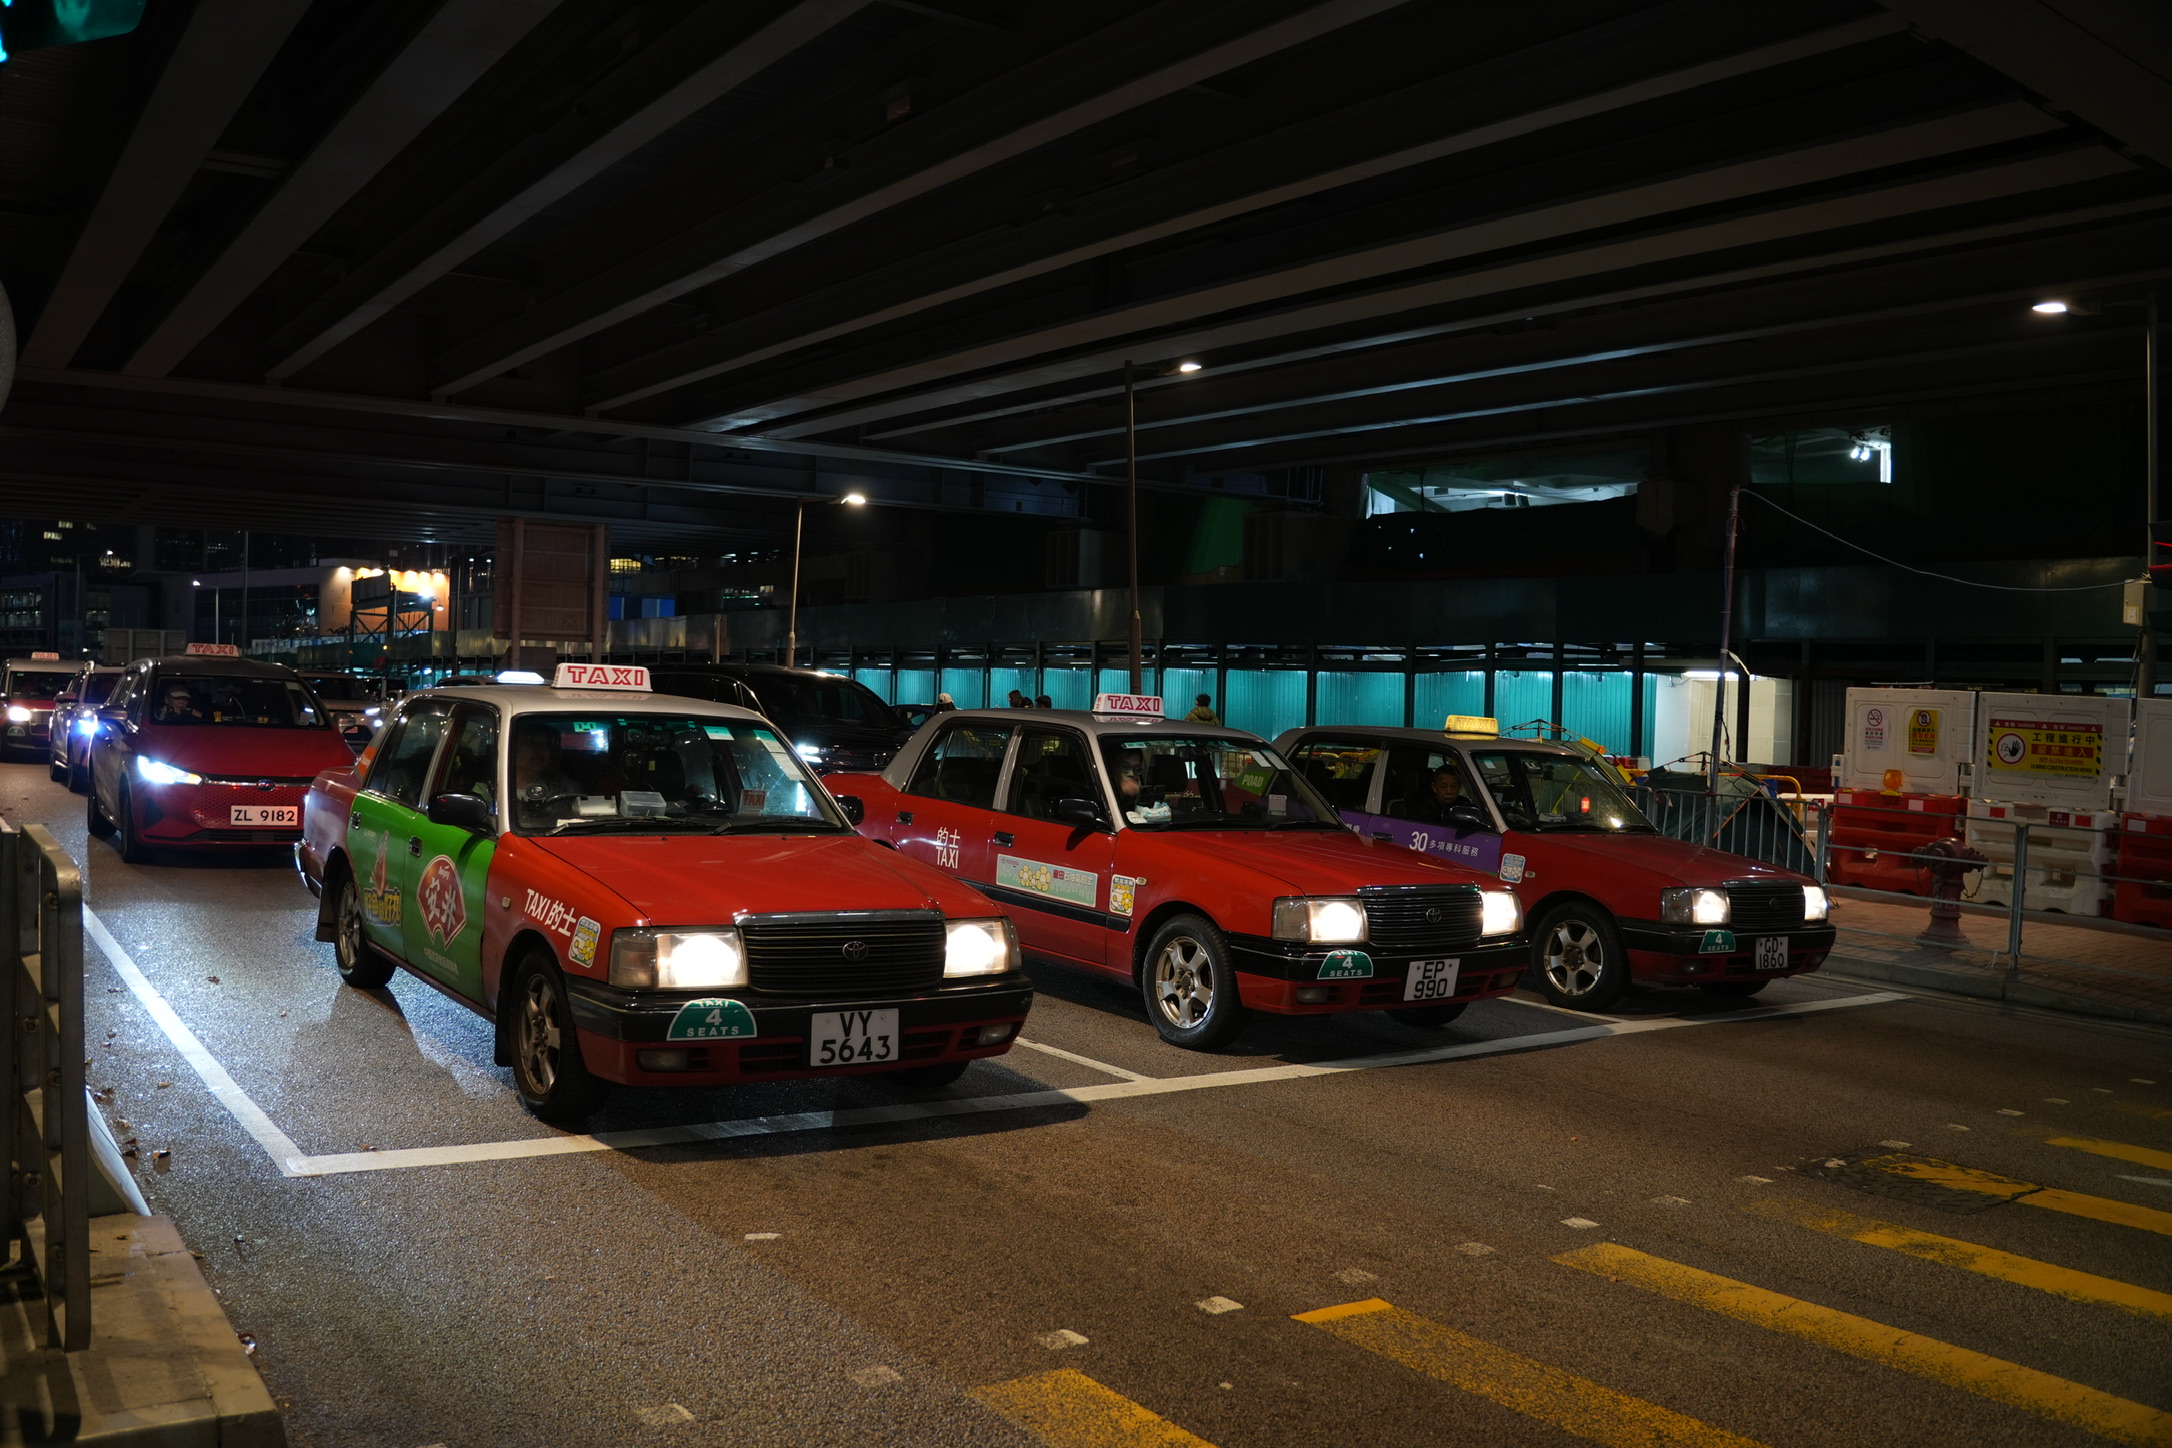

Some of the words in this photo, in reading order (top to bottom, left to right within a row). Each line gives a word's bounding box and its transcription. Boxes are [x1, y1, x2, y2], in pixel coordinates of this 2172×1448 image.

[192, 643, 235, 655] TAXI
[567, 665, 645, 686] TAXI
[1107, 695, 1160, 712] TAXI
[1456, 716, 1497, 731] TAXI
[2032, 733, 2095, 745] 工程進行中
[234, 809, 253, 822] ZL
[260, 810, 295, 822] 9182
[937, 826, 961, 849] 的士
[1409, 830, 1429, 852] 30
[1428, 839, 1479, 858] 多項專科服務
[936, 846, 960, 870] TAXI
[525, 888, 551, 921] TAXI
[544, 900, 577, 937] 的士
[1715, 933, 1723, 944] 4
[1764, 937, 1779, 953] GD
[1342, 955, 1353, 969] 4
[1759, 953, 1785, 969] 1860
[1330, 969, 1363, 977] SEATS
[1422, 960, 1446, 980] EP
[1413, 978, 1448, 999] 990
[697, 1000, 730, 1008] TAXI
[705, 1008, 723, 1026] 4
[839, 1011, 873, 1036] VY
[686, 1025, 739, 1037] SEATS
[820, 1035, 891, 1065] 5643
